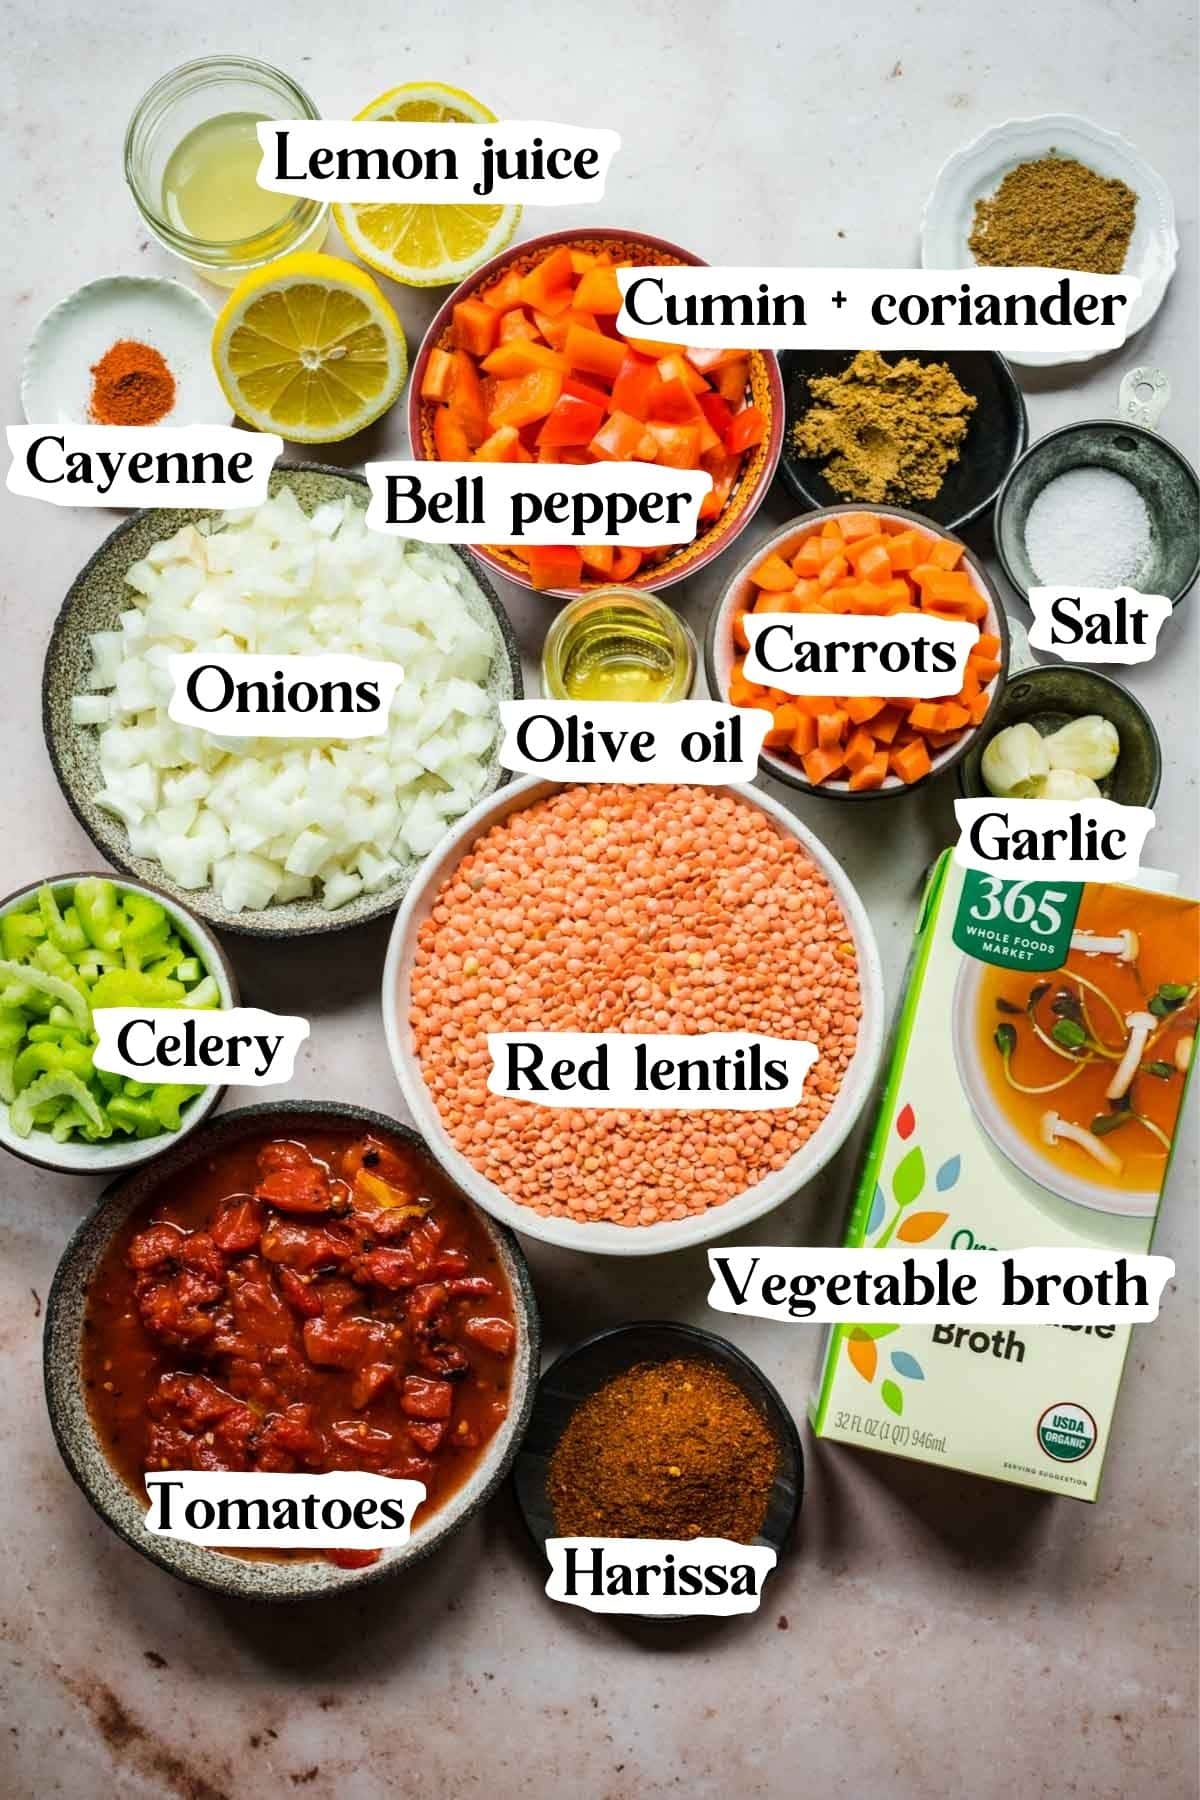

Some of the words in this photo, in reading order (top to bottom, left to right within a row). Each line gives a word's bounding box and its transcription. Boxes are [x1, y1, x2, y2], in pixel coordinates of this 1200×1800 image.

[969, 876, 1068, 936] 365
[966, 925, 1010, 944] WHOLE
[1014, 936, 1056, 954] FOODS
[982, 942, 1035, 961] MARKET
[932, 1324, 1025, 1363] Broth
[834, 1411, 851, 1430] 32
[850, 1415, 862, 1433] FL
[864, 1418, 880, 1437] OZ
[911, 1429, 947, 1454] 946mL
[1052, 1415, 1085, 1434] USDA
[1045, 1431, 1086, 1449] ORGANIC
[1003, 1462, 1037, 1474] SERVING
[1038, 1470, 1088, 1487] SUGGESTION
